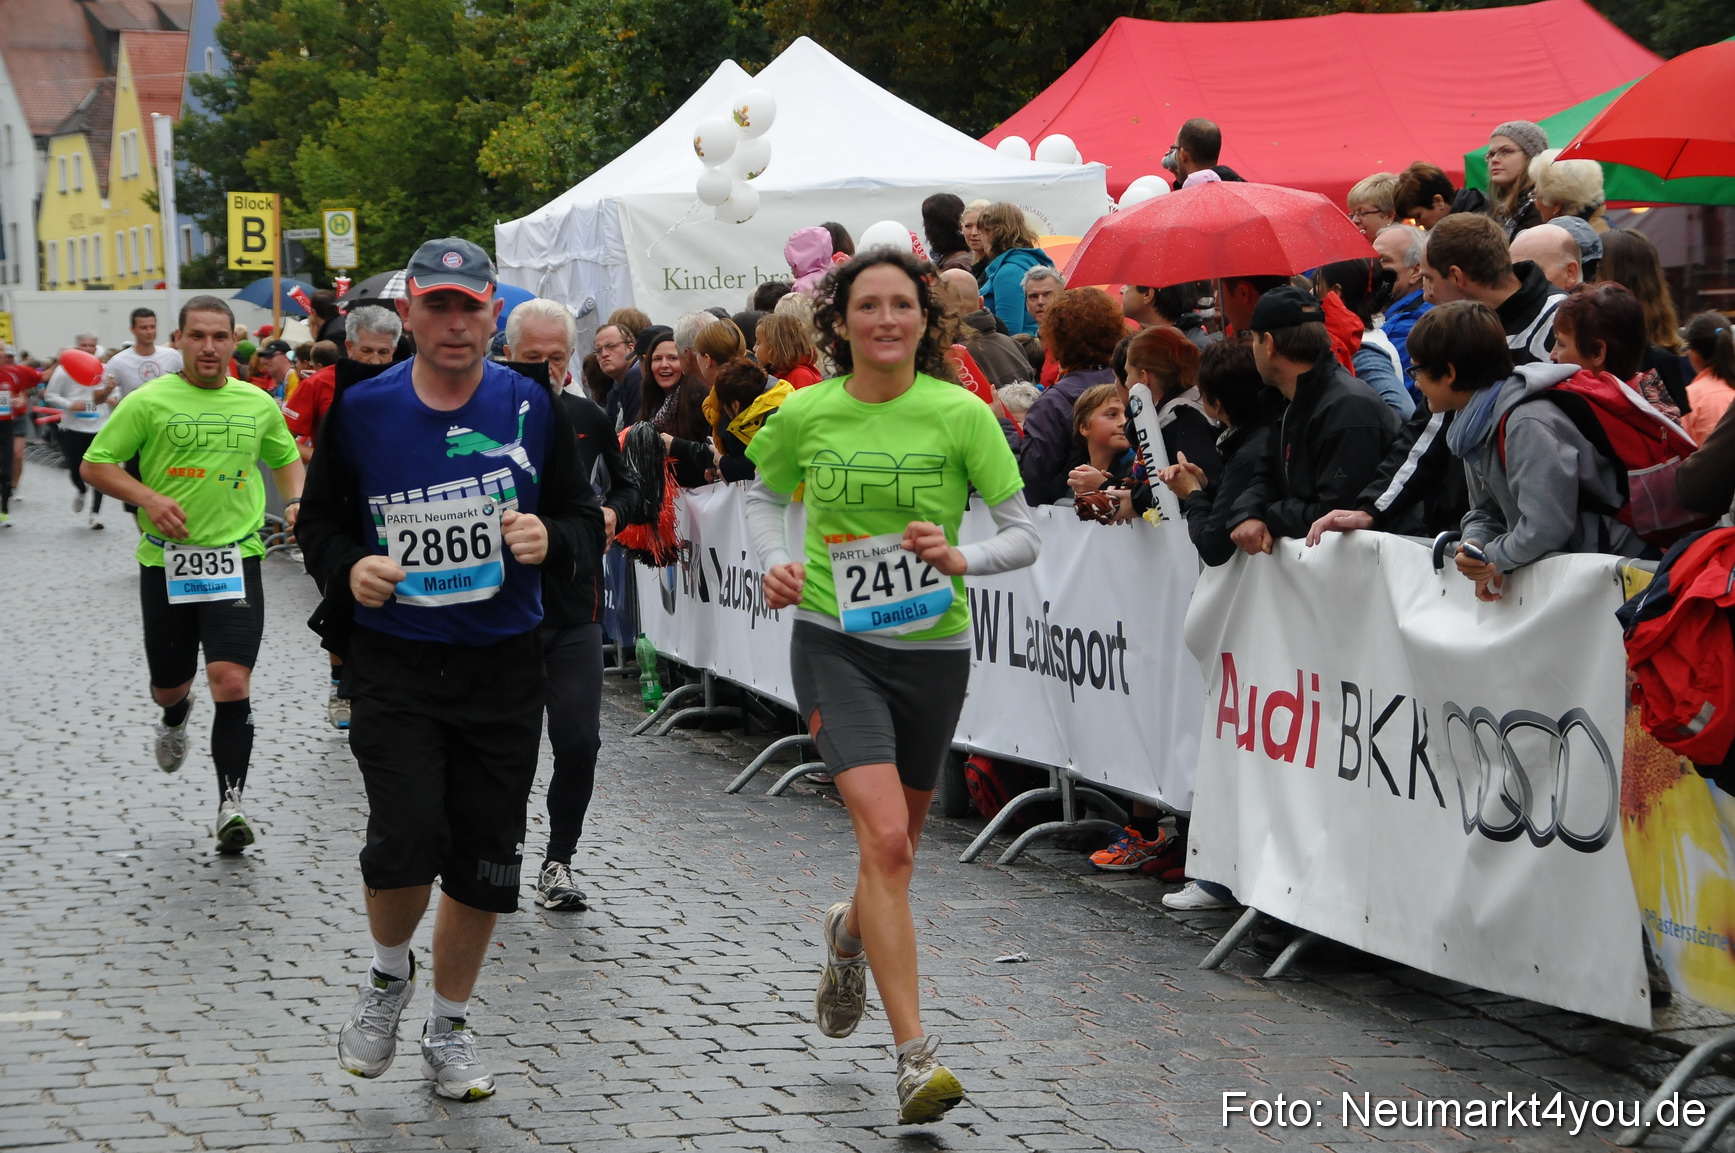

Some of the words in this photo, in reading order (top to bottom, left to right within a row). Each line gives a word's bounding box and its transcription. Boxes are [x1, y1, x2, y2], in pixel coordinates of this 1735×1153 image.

[234, 195, 274, 210] Block
[242, 216, 267, 253] B
[662, 266, 746, 291] Kinder
[165, 412, 256, 448] OPF
[167, 467, 206, 479] MERZ
[810, 449, 947, 508] OPF
[386, 513, 423, 525] PARTL
[424, 508, 479, 523] Neumarkt
[399, 521, 492, 567] 2866
[832, 549, 871, 562] PARTL
[172, 550, 235, 577] 2935
[183, 582, 228, 593] Christian
[423, 573, 472, 592] Martin
[846, 554, 940, 603] 2412
[871, 601, 928, 627] Daniela
[966, 586, 1001, 664] W
[1216, 651, 1321, 769] Audi
[1337, 680, 1447, 810] BKK
